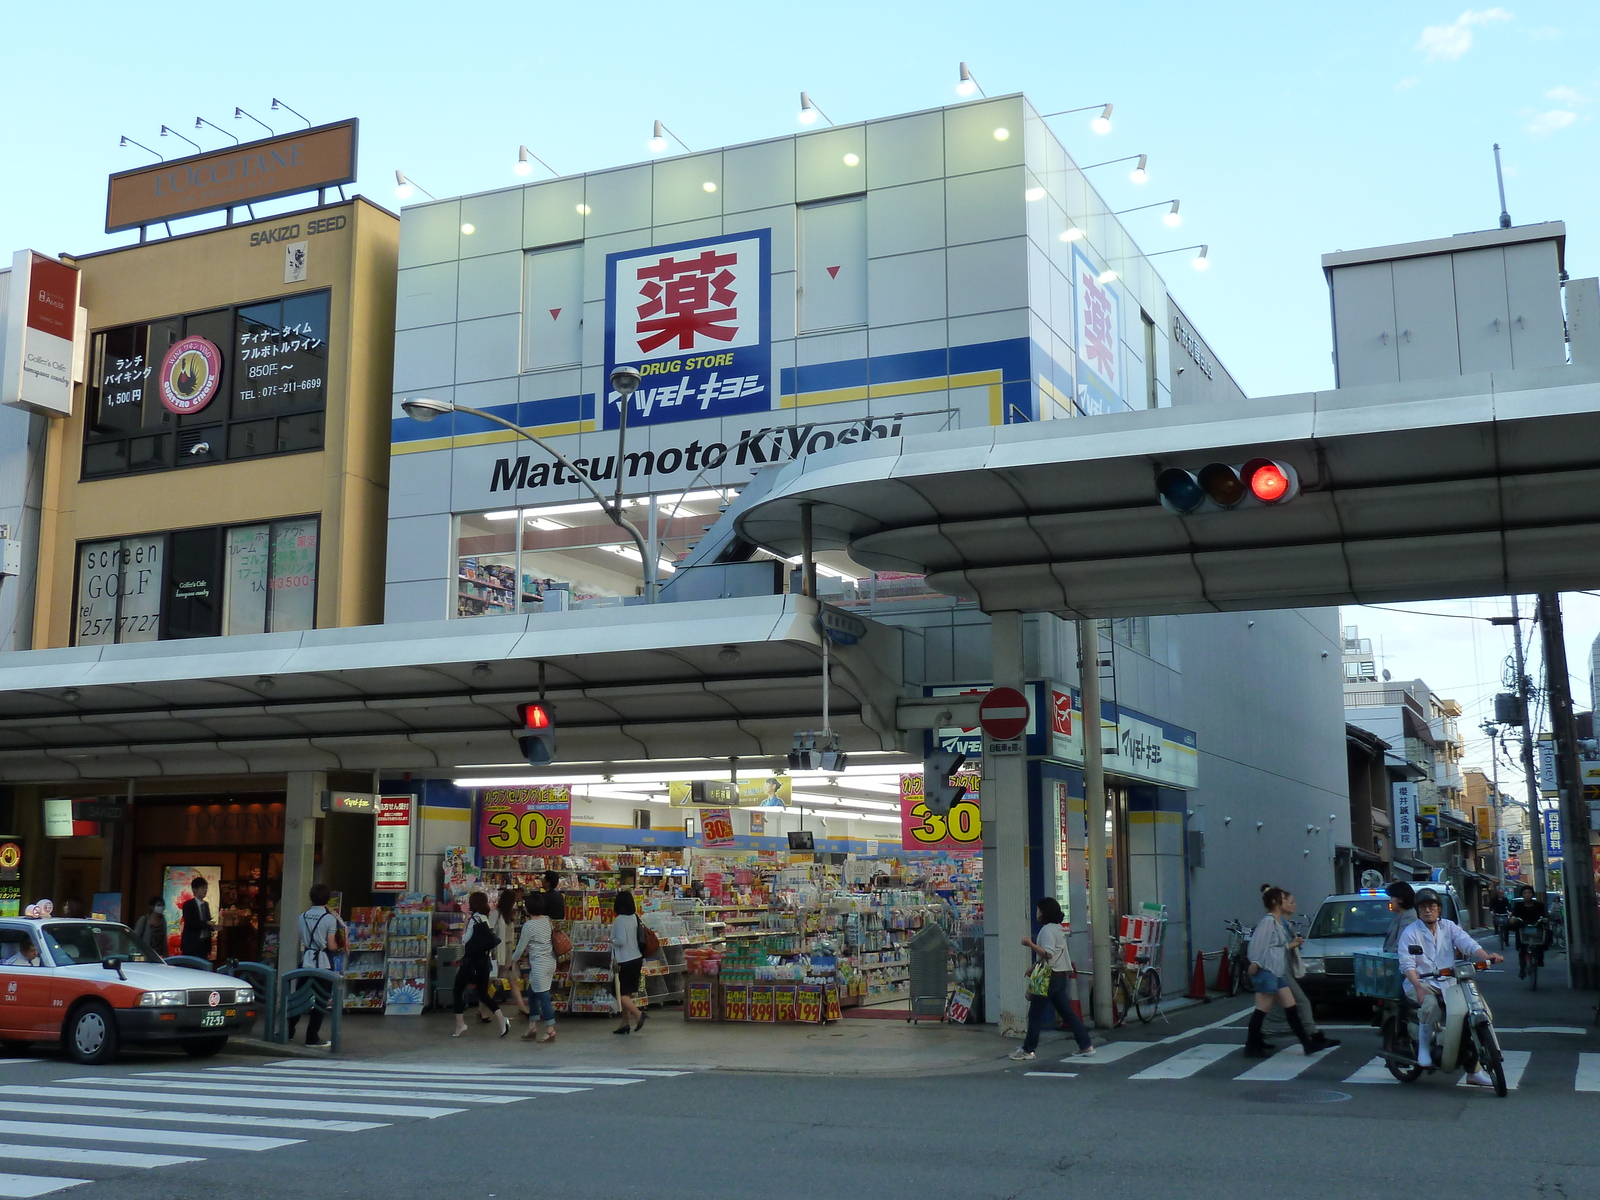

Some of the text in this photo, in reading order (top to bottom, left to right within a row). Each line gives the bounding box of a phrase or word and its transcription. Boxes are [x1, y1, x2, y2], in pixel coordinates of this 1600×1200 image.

[154, 144, 305, 196] L'OCCITANE
[250, 215, 346, 247] SAKIZO SEED
[636, 250, 740, 354] 薬
[1082, 272, 1115, 383] 薬
[241, 337, 322, 361] フルボトルワイン
[116, 355, 143, 370] ランチ
[639, 353, 734, 376] DRUG STORE
[104, 366, 152, 385] バイキング
[164, 374, 214, 408] QUATTRO CINQUE
[608, 372, 765, 417] マツモトキヨシ
[490, 412, 903, 492] Matsumoto KiYoshi
[87, 543, 157, 569] screen
[241, 554, 268, 565] ゴルフ
[88, 569, 152, 599] GOLF
[251, 580, 266, 592] 1人
[80, 603, 93, 617] tel
[81, 617, 113, 636] 257
[942, 736, 982, 755] マツモ
[989, 743, 1022, 753] 自転車を除く
[487, 811, 565, 849] 30% OFF
[910, 800, 981, 844] 30
[565, 906, 583, 921] 105
[690, 1000, 710, 1018] 699
[751, 1003, 773, 1021] 399
